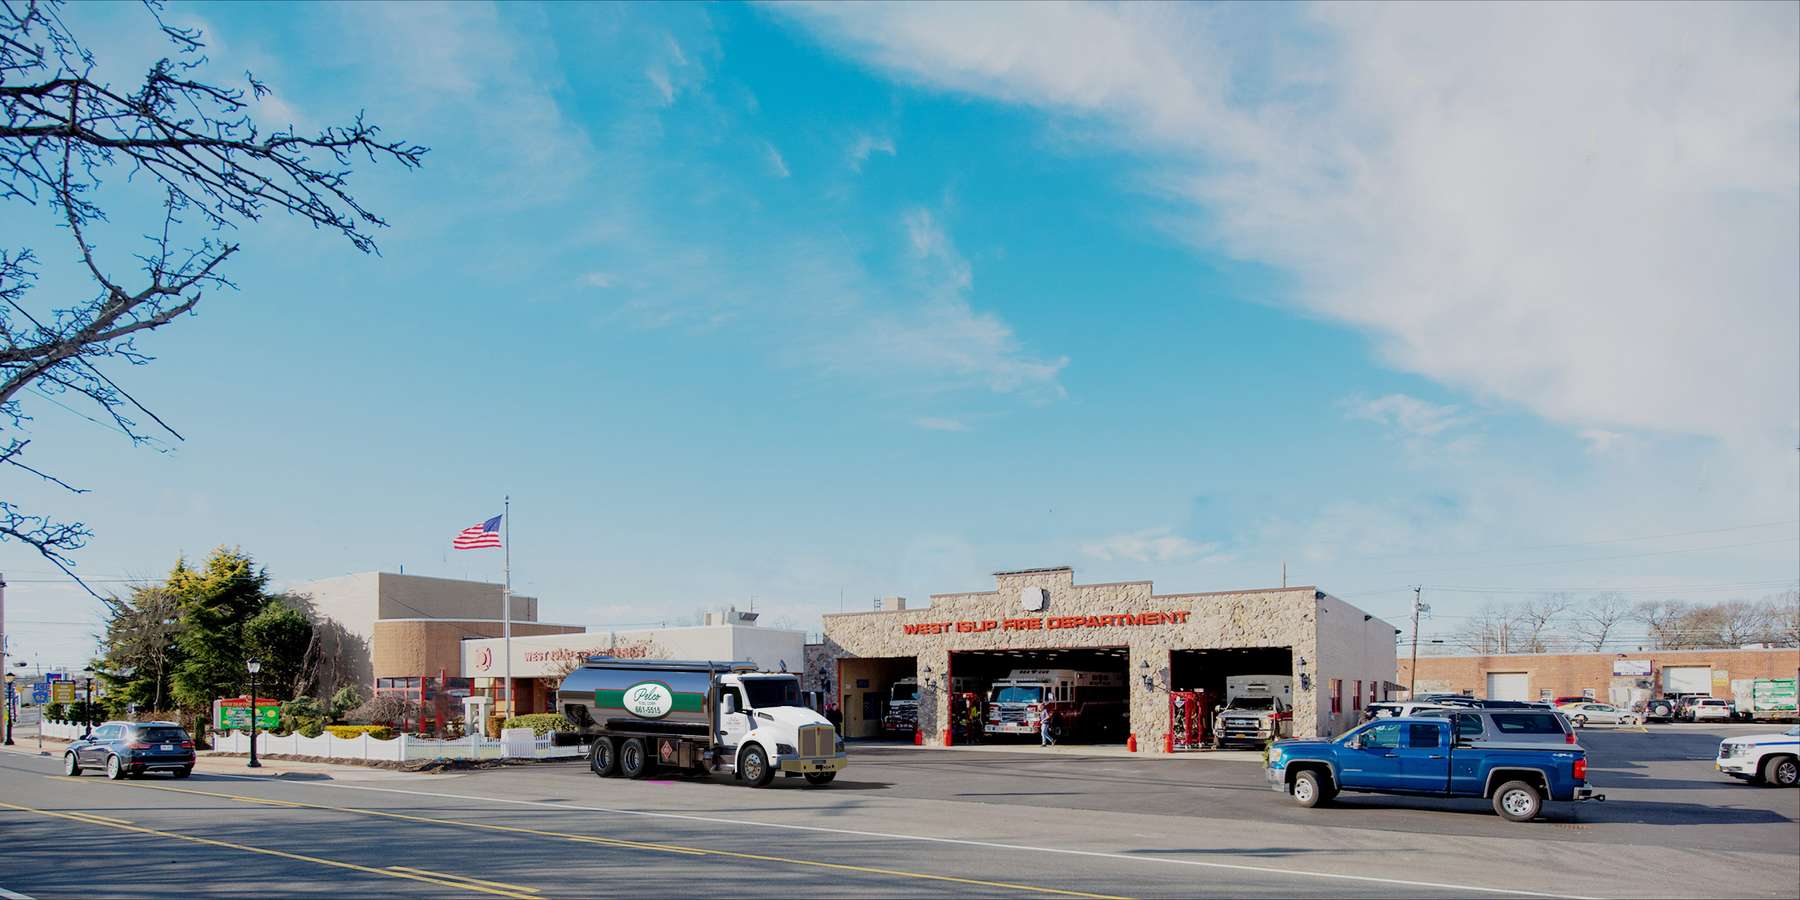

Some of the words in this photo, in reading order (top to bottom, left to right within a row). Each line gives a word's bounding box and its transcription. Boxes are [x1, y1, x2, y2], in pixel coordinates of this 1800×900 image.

[903, 622, 950, 635] WEST
[955, 620, 998, 633] ISLIP
[1003, 617, 1042, 631] FIRE
[1046, 609, 1191, 630] DEPARTMENT
[525, 650, 550, 662] WEST
[633, 686, 661, 702] Pelco
[635, 705, 661, 714] 661-5515
